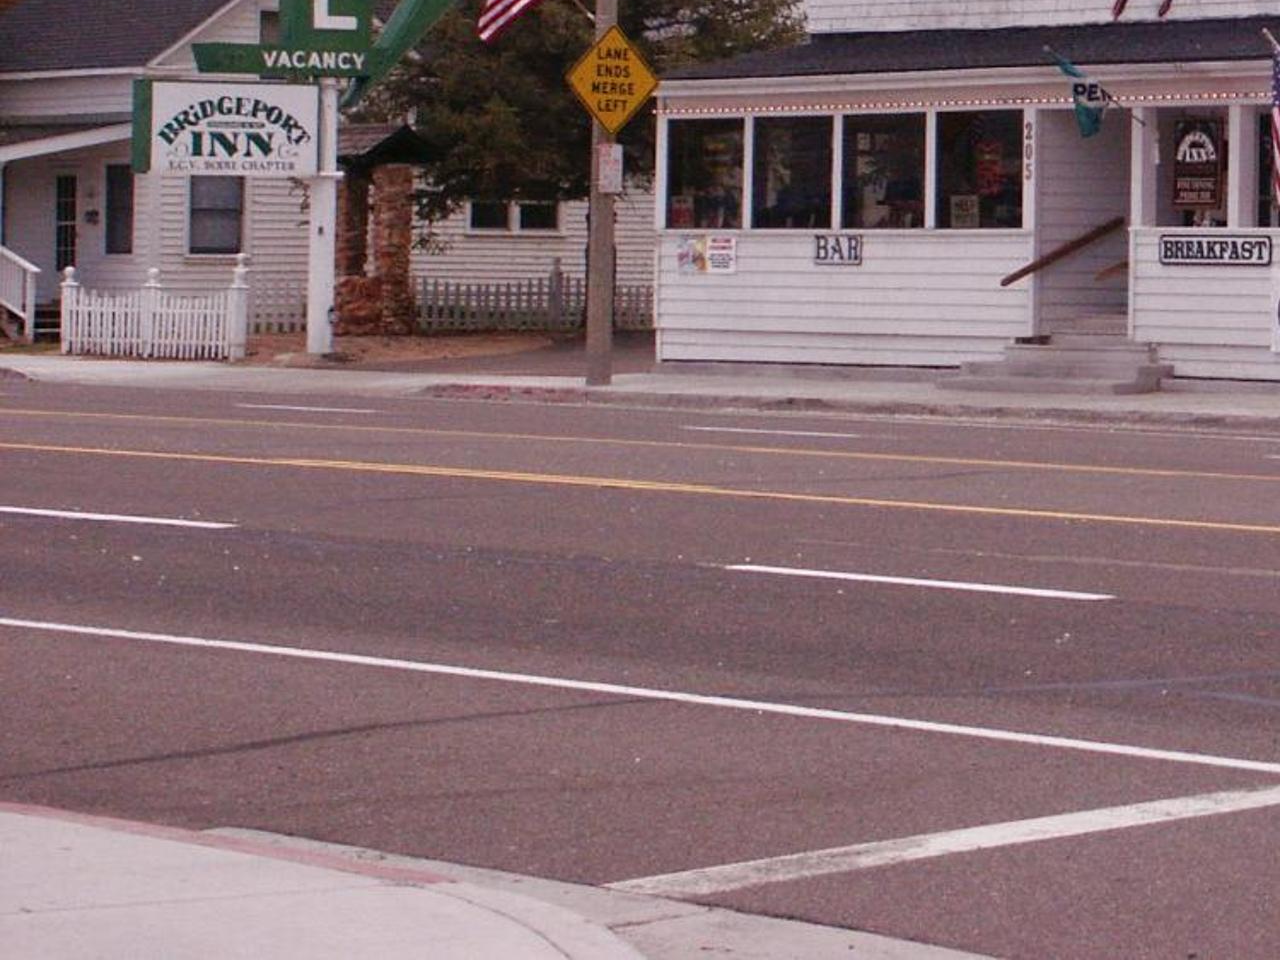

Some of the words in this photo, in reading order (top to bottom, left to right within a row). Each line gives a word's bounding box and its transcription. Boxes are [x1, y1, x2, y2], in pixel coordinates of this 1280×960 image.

[261, 50, 365, 70] VACANCY
[597, 47, 630, 61] LANE
[596, 64, 631, 79] ENDS
[592, 82, 635, 96] MERGE
[1073, 83, 1111, 102] PEN
[597, 99, 628, 114] LEFT
[190, 131, 274, 158] INN
[1024, 122, 1034, 181] 205
[241, 161, 296, 172] CHAPTER
[816, 235, 860, 261] BAR
[1162, 241, 1268, 262] BREAKFAST
